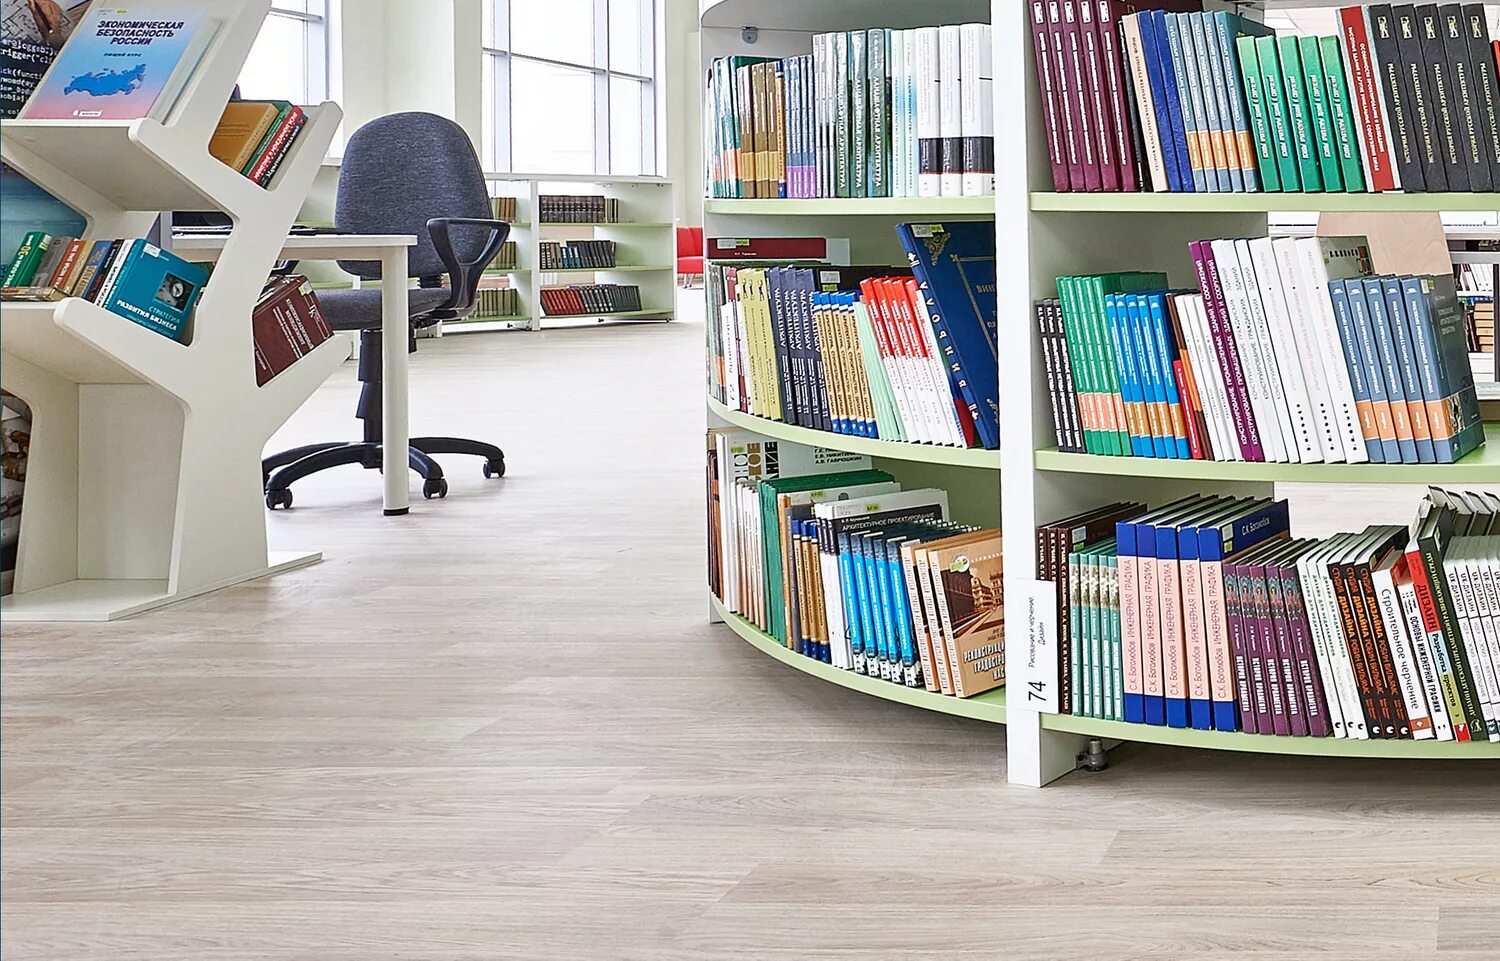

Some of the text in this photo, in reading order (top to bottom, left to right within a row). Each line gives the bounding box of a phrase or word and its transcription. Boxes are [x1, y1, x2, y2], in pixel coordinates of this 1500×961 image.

[96, 28, 174, 38] БЕЗОПАСНОСТЬ
[98, 20, 184, 30] ЭКОНОМИЧЕСКАЯ
[110, 37, 152, 46] РОССИИ
[1130, 36, 1138, 54] ФОРМ
[1359, 42, 1370, 77] ОСОБЕННОСТИ
[1387, 63, 1411, 163] ИСТОРИЯ РУССКОЙ АРХИТЕКТУРЫ
[1365, 124, 1376, 156] СООРУЖЕНИЯ
[838, 136, 846, 187] АРХИТЕКТУРА
[1195, 259, 1211, 299] СООРУЖЕНИЙ
[1207, 258, 1223, 299] СООРУЖЕНИЙ
[116, 299, 149, 318] РАЗВИТИЯ
[150, 313, 177, 332] БИЗНЕСА
[149, 306, 180, 324] СТРАТЕГИЯ
[773, 287, 785, 347] АРХИТЕКТУРА
[790, 289, 801, 349] АРХИТЕКТУРА
[800, 288, 811, 350] АРХИТЕКТУРА
[1207, 307, 1219, 333] ЗДАНИЙ
[1219, 307, 1231, 333] ЗДАНИЙ
[1244, 266, 1282, 400] КОНСТРУИРОВАНИЕ ГРАЖДАНСКИХ ЗДАНИЙ
[1214, 335, 1232, 385] ПРОМЫШЛЕННЫХ
[1225, 335, 1243, 385] ПРОМЫШЛЕННЫХ
[1227, 386, 1247, 445] КОНСТРУИРОВАНИЕ
[1237, 385, 1258, 445] КОНСТРУИРОВАНИЕ
[826, 456, 862, 464] ГАВРЮШКИН
[841, 511, 934, 531] АРХИТЕКТУРНОЕ ПРОЕКТИРОВАНИЕ
[1123, 560, 1132, 591] ГРАФИКА
[1125, 593, 1134, 637] ИНЖЕНЕРНАЯ
[1415, 582, 1439, 630] ДИЗАЙН
[1027, 633, 1035, 667] Рисование
[1037, 621, 1045, 644] Дизайн
[1331, 566, 1369, 695] СТУДИЯ ДИЗАЙНА РОБИН ВИЛЬЯМС
[1345, 566, 1383, 695] СТУДИЯ ДИЗАЙНА РОБИН ВИЛЬЯМС
[1378, 587, 1418, 710] Строительное черчение
[1425, 551, 1476, 717] ДИЗАЙН ДЕТСКОЙ ПРЕДМЕТНОЙ РАЗВИВАЮЩЕЙ СРЕДЫ
[1127, 640, 1136, 676] Боголюбов
[1409, 615, 1441, 713] ОСНОВЫ ИНЖЕНЕРНОЙ ГРАФИКИ
[1431, 632, 1456, 707] Разработка проектов
[1027, 681, 1046, 701] 74
[1236, 655, 1249, 711] ИСТОРИЯ ОРНАМЕНТА
